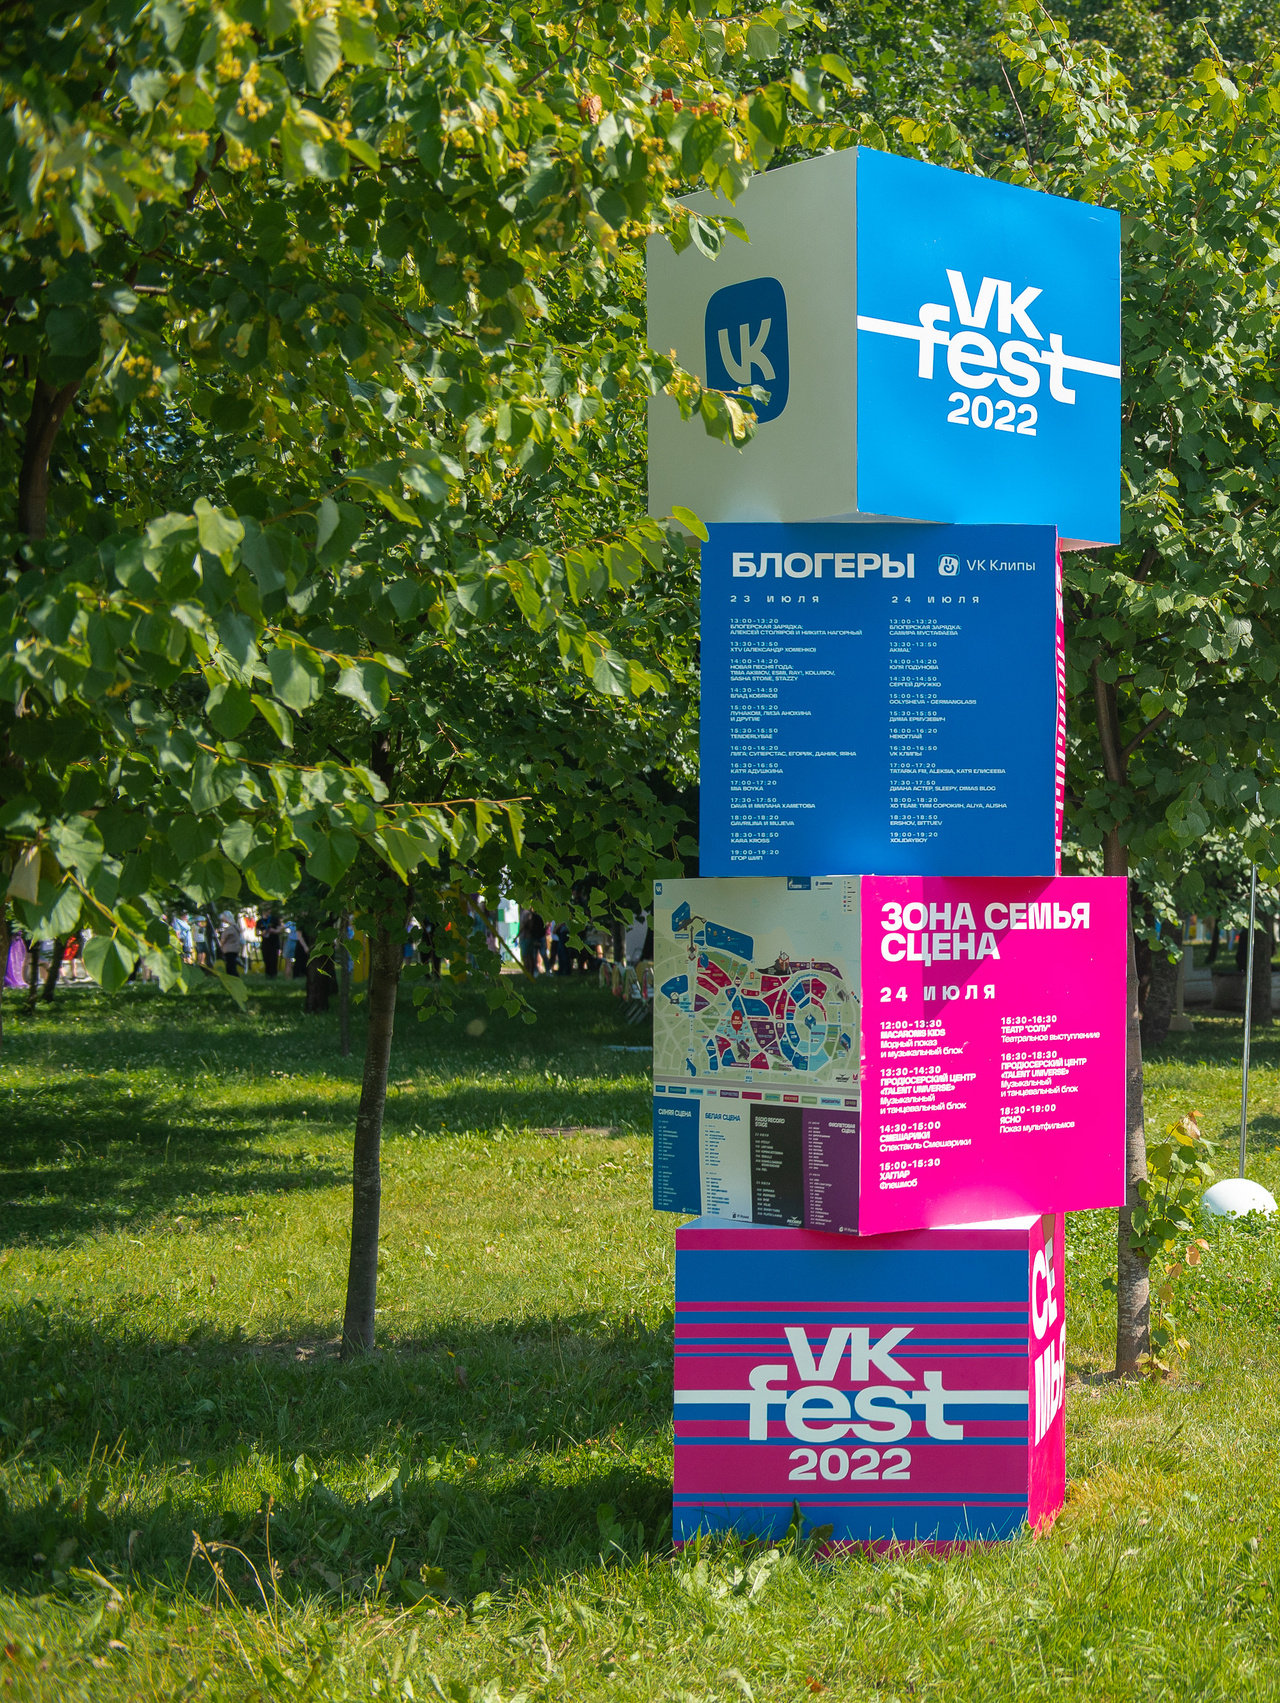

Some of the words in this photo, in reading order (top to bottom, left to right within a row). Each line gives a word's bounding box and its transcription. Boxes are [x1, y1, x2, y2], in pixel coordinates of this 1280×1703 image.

[946, 268, 1044, 341] VK
[717, 317, 776, 385] VK
[918, 302, 1076, 405] fest
[947, 391, 1038, 436] 2022
[732, 552, 915, 579] БЛОГЕРЫ
[966, 559, 986, 572] VK
[990, 559, 1036, 572] Клипы
[730, 595, 751, 603] 23
[766, 595, 820, 603] ИЮЛЯ
[891, 596, 912, 604] 24
[927, 596, 980, 604] ИЮЛЯ
[880, 902, 977, 931] ЗОНА
[984, 902, 1090, 931] СЕМЬЯ
[880, 931, 1001, 967] СЦЕНА
[880, 986, 908, 1002] 24
[923, 984, 996, 1001] ИЮЛЯ
[880, 1019, 942, 1029] 12:00-13:30
[1001, 1015, 1057, 1025] 15:30-16:30
[927, 1029, 946, 1037] KIDS
[1001, 1025, 1024, 1034] ТЕАТР
[880, 1039, 913, 1049] Модный
[887, 1047, 942, 1059] музыкальный
[943, 1046, 963, 1055] блок
[1001, 1050, 1057, 1061] 16:30-18:30
[1064, 1058, 1087, 1067] ЦЕНТР
[880, 1066, 941, 1077] 13:30-14:30
[880, 1073, 948, 1086] ПРОДЮСЕРСКИЙ
[949, 1073, 976, 1083] ЦЕНТР
[1061, 1085, 1078, 1093] блок
[946, 1102, 966, 1110] блок
[1000, 1104, 1056, 1115] 18:30-19:00
[674, 1110, 692, 1118] СЦЕНА
[705, 1112, 722, 1120] БЕЛАЯ
[722, 1114, 741, 1122] СЦЕНА
[1000, 1115, 1021, 1124] ЯСНО
[879, 1121, 941, 1133] 14:30-15:00
[1000, 1125, 1021, 1133] Показ
[879, 1131, 930, 1142] СМЕШАРИКИ
[879, 1142, 922, 1152] Спектакль
[879, 1158, 941, 1171] 15:00-15:30
[879, 1178, 918, 1189] Флешмоб
[783, 1327, 915, 1382] VK
[748, 1364, 964, 1443] fest
[788, 1447, 911, 1481] 2022
